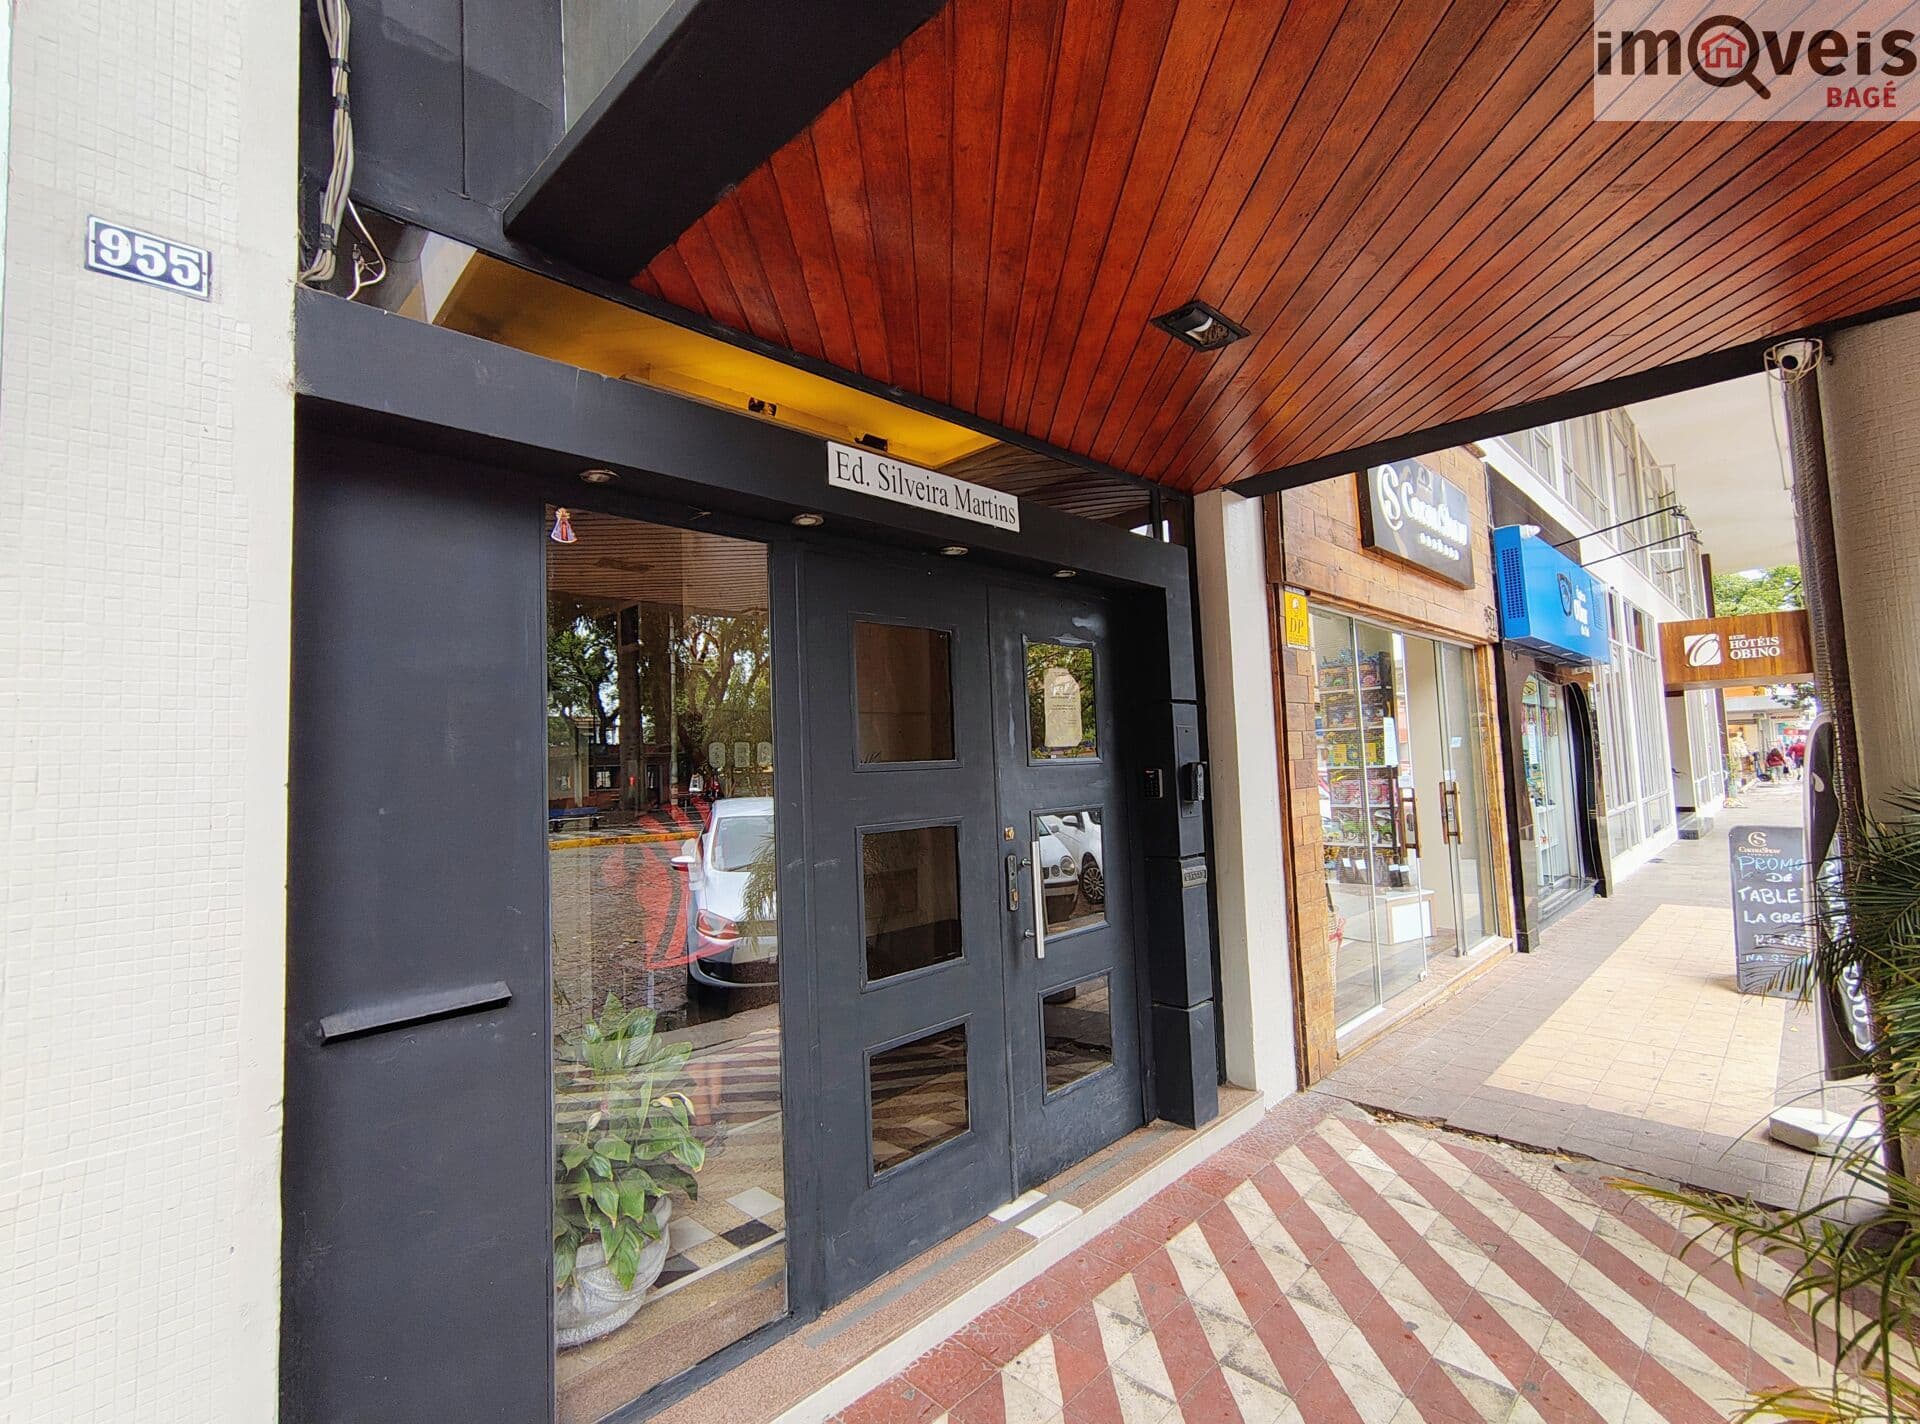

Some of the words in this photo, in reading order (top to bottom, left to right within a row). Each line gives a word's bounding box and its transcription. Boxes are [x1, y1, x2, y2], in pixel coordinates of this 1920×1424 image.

[99, 227, 201, 287] 955
[836, 450, 870, 487] Ed.
[878, 462, 949, 507] Silveira
[954, 484, 1016, 525] Martins
[1730, 646, 1781, 660] OBINO
[1765, 872, 1793, 882] DE
[1738, 886, 1804, 904] TABLE
[1743, 910, 1767, 924] LA
